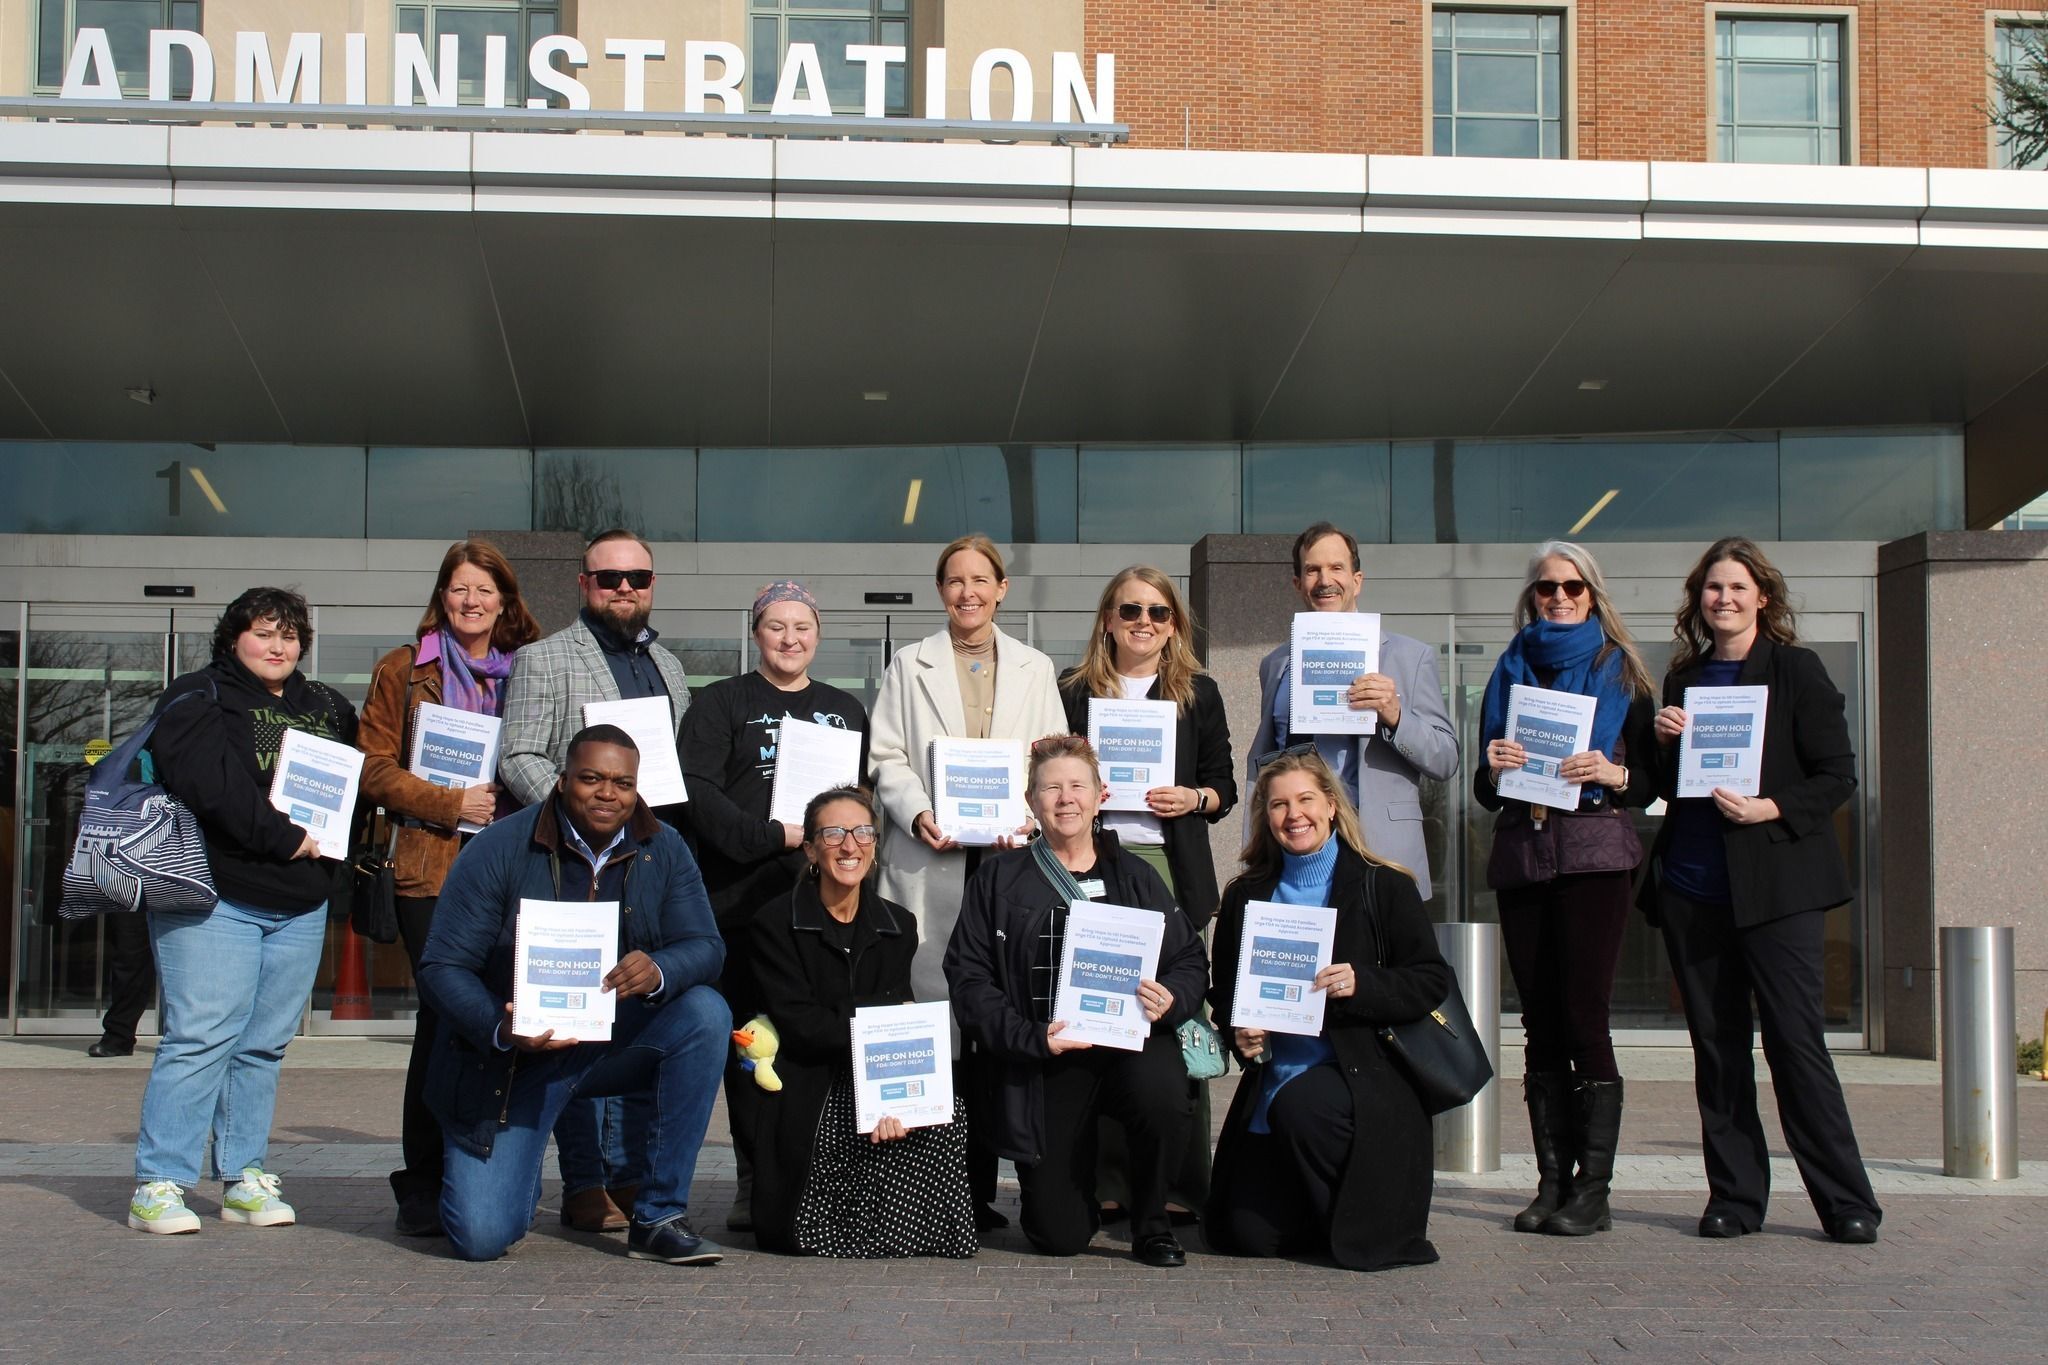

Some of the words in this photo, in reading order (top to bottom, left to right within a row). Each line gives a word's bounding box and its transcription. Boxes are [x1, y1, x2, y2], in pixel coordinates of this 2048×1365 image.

[59, 27, 1115, 124] ADMINISTRATION
[156, 461, 180, 516] 1
[1138, 739, 1161, 747] HOLD
[1516, 727, 1537, 737] HOPE
[1538, 731, 1551, 740] ON
[1553, 733, 1576, 744] HOLD
[423, 743, 444, 754] HOPE
[445, 748, 458, 757] ON
[459, 751, 482, 762] HOLD
[287, 772, 308, 785] HOPE
[308, 779, 321, 789] ON
[322, 783, 344, 796] HOLD
[529, 959, 554, 967] HOPE
[556, 960, 571, 968] ON
[573, 961, 600, 969] HOLD
[1252, 949, 1276, 959] HOPE
[1277, 952, 1291, 961] ON
[1293, 954, 1317, 963] HOLD
[1073, 961, 1098, 972] HOPE
[1098, 965, 1113, 974] ON
[1114, 967, 1140, 978] HOLD
[866, 1054, 891, 1063] HOPE
[892, 1052, 906, 1060] ON
[908, 1049, 934, 1059] HOLD
